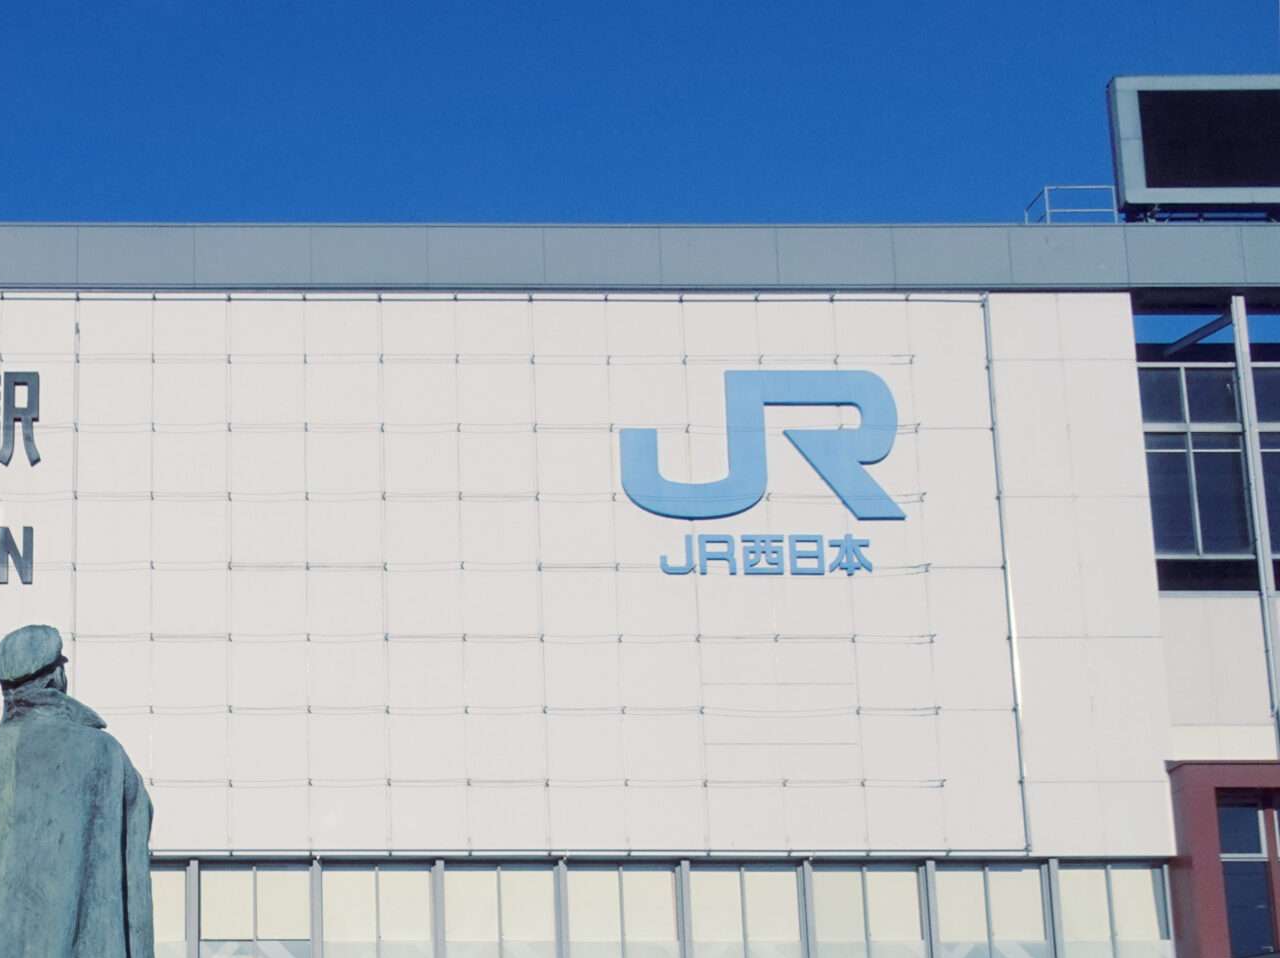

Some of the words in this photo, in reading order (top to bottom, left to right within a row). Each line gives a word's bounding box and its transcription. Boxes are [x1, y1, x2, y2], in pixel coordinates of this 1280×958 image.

[619, 370, 906, 521] JR
[660, 533, 873, 577] JR西日本
